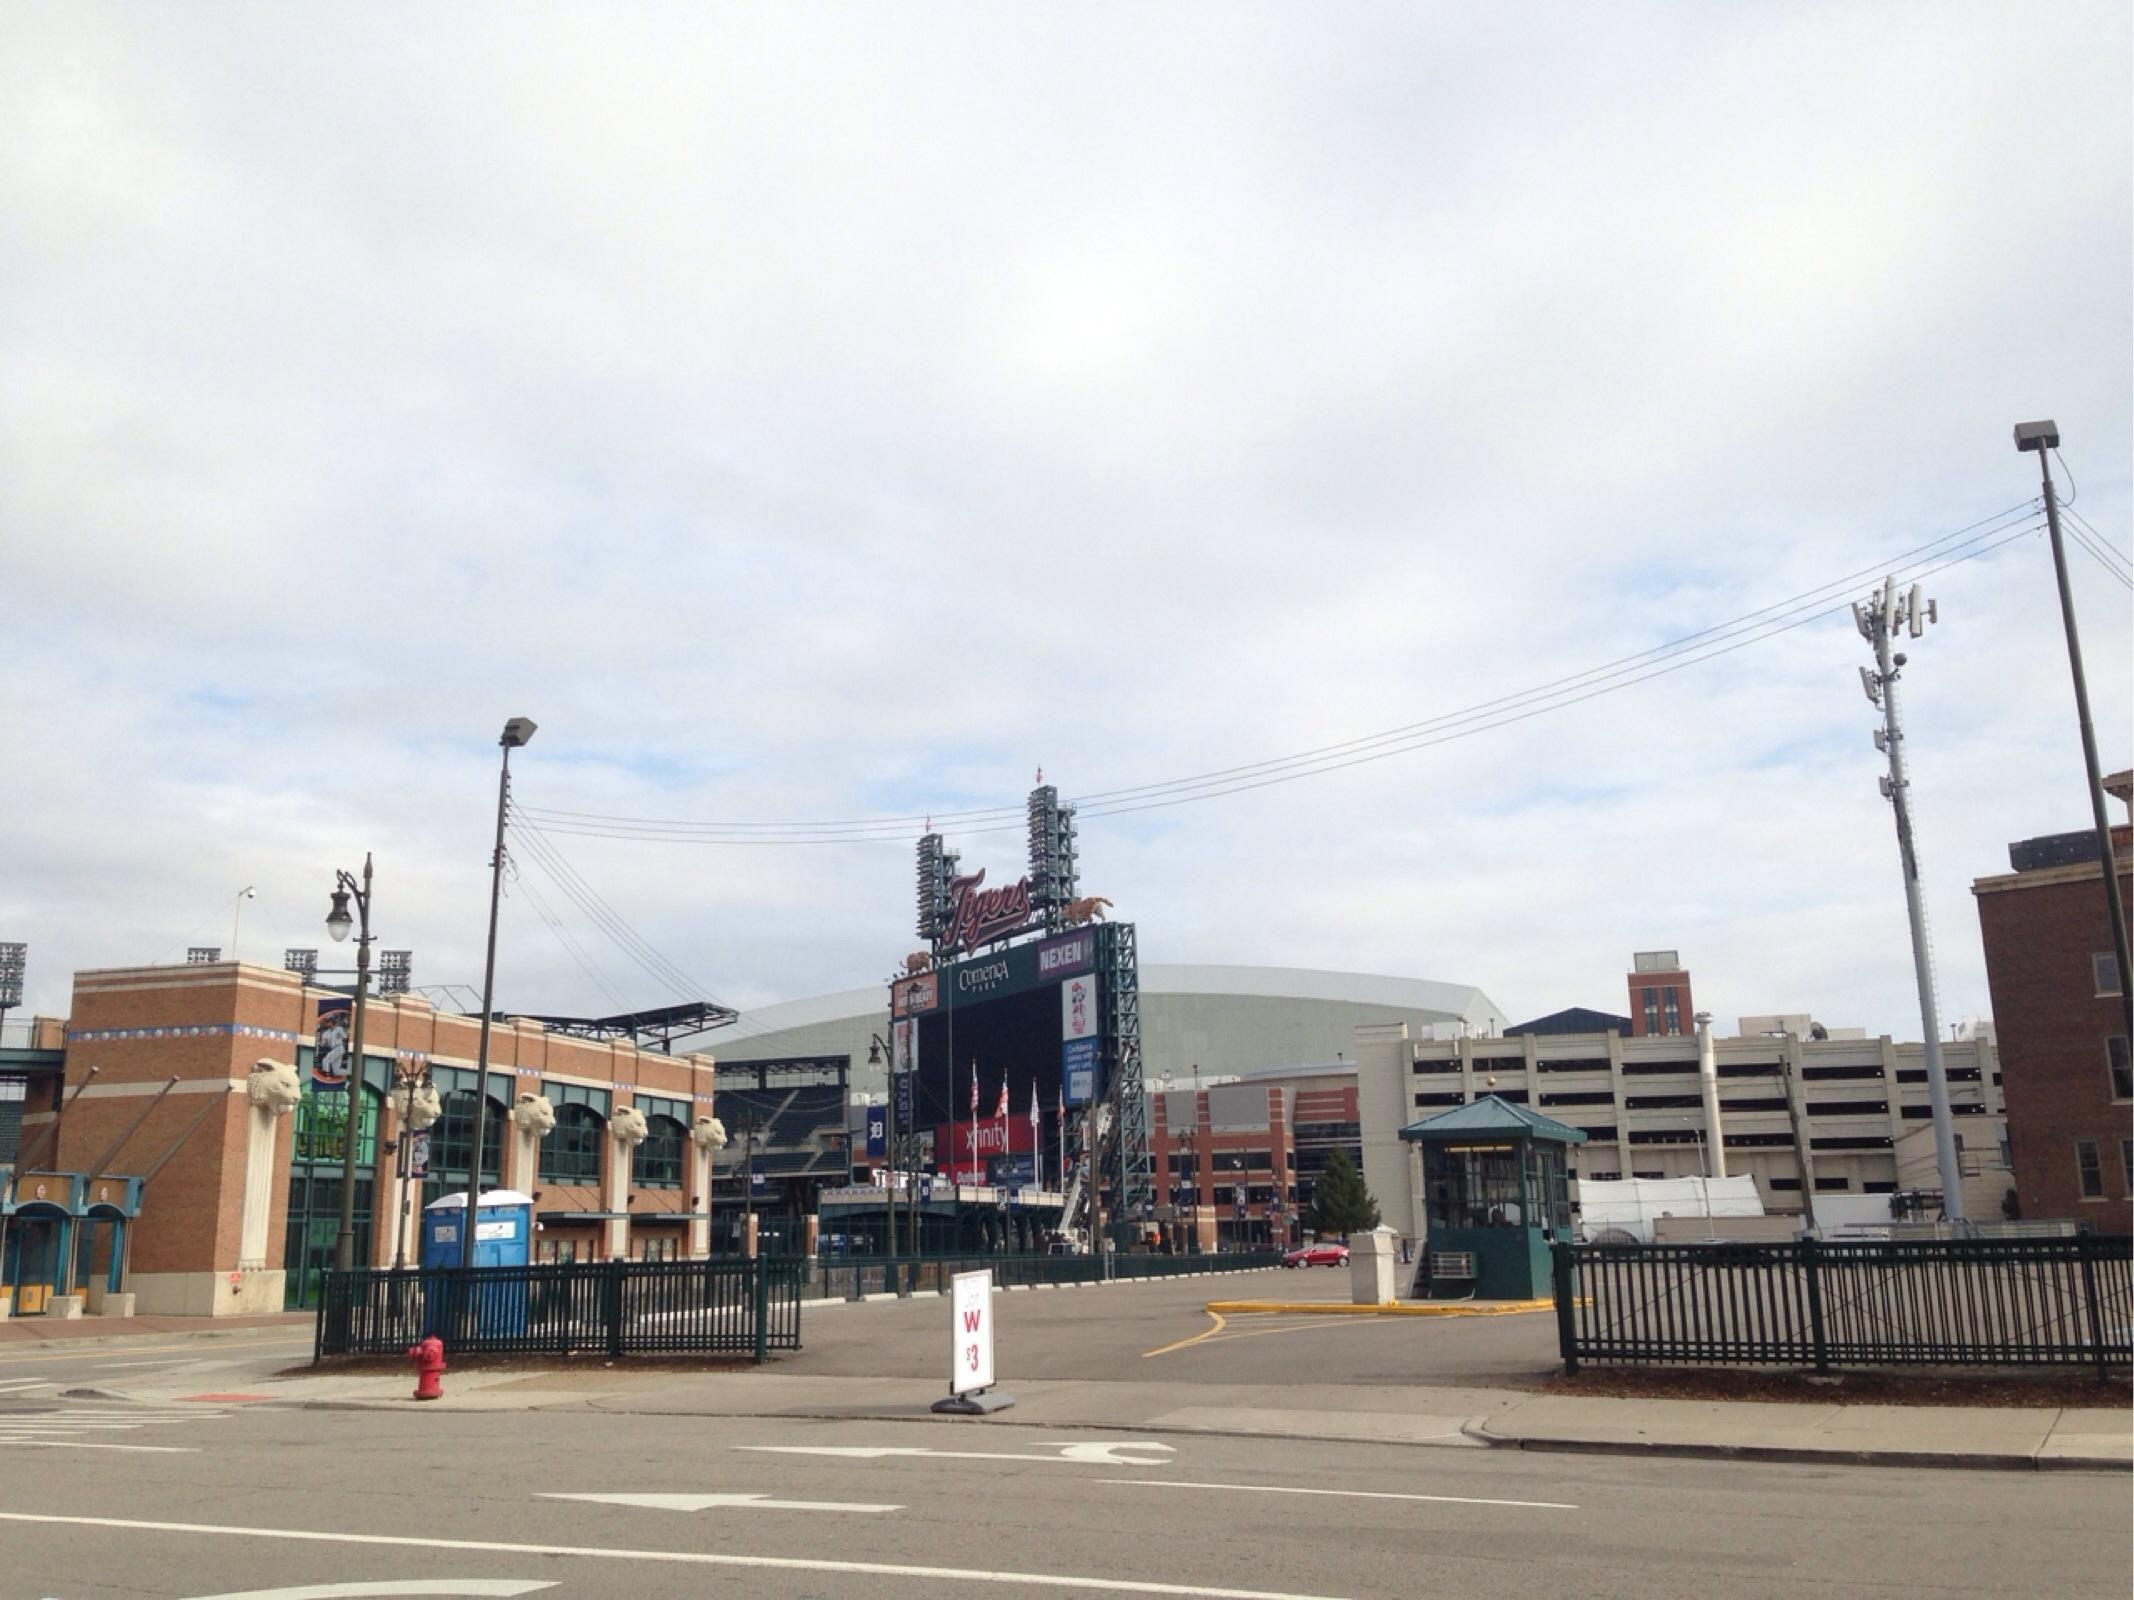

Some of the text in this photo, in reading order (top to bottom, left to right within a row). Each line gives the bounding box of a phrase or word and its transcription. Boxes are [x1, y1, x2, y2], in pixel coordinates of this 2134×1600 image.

[940, 867, 1031, 957] Tigers
[1040, 941, 1081, 971] NEXEN
[966, 1122, 1008, 1151] xinity
[963, 1309, 981, 1333] W
